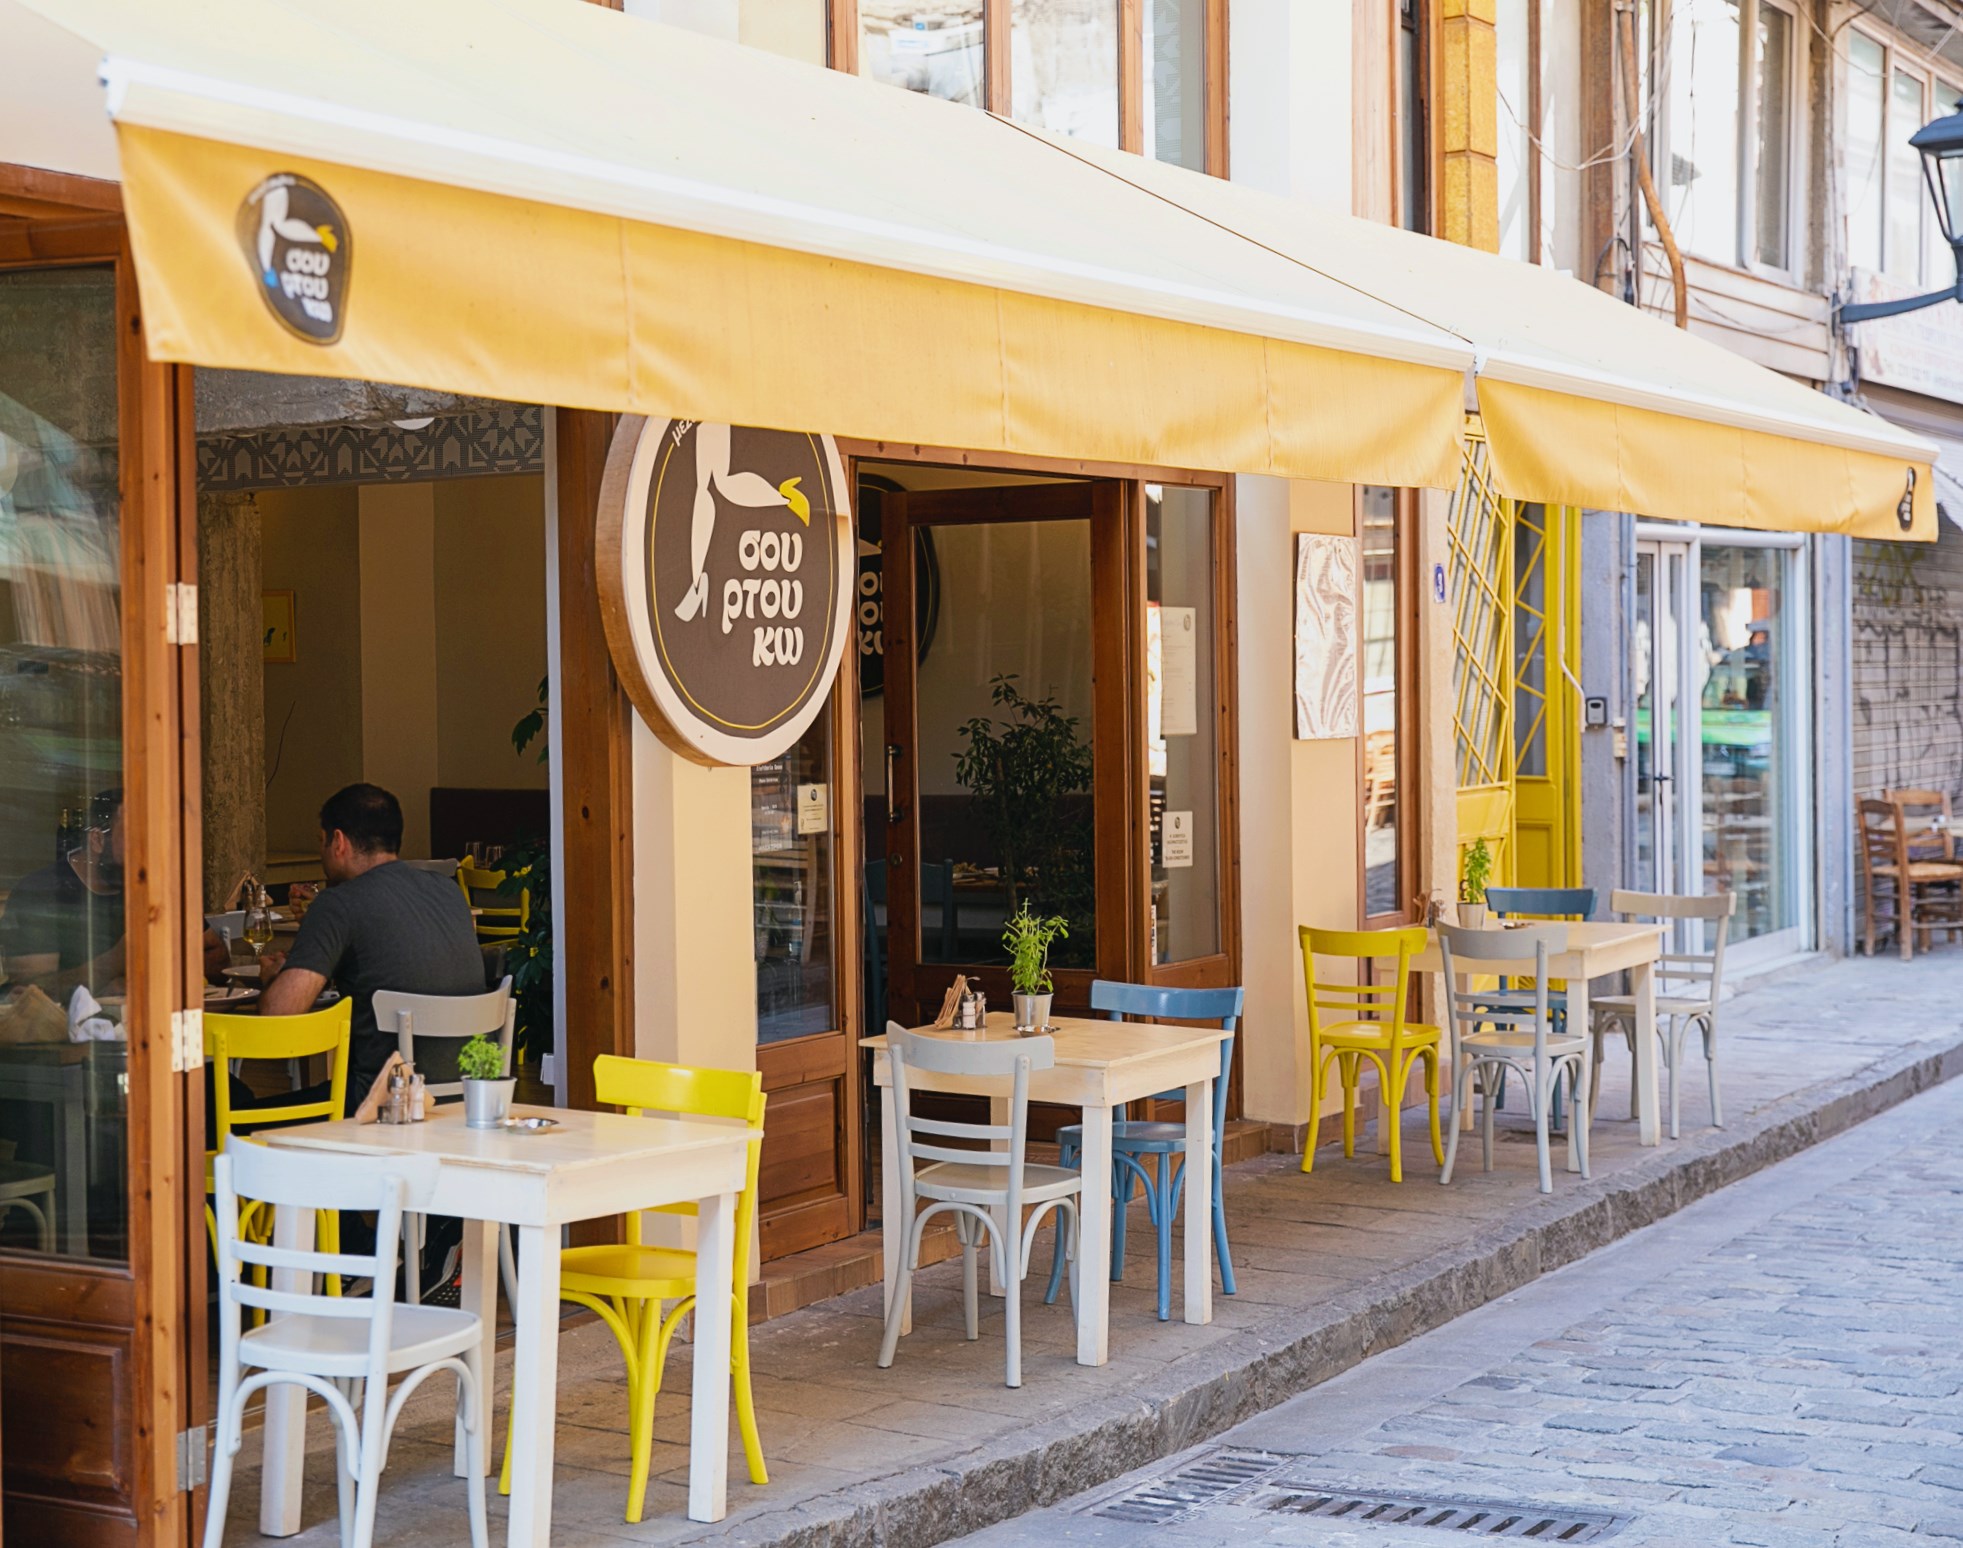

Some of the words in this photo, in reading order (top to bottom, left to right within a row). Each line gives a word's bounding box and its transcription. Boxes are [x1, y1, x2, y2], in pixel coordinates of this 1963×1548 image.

[739, 529, 803, 572] σου
[722, 578, 803, 634] ρτου
[752, 626, 804, 667] κω
